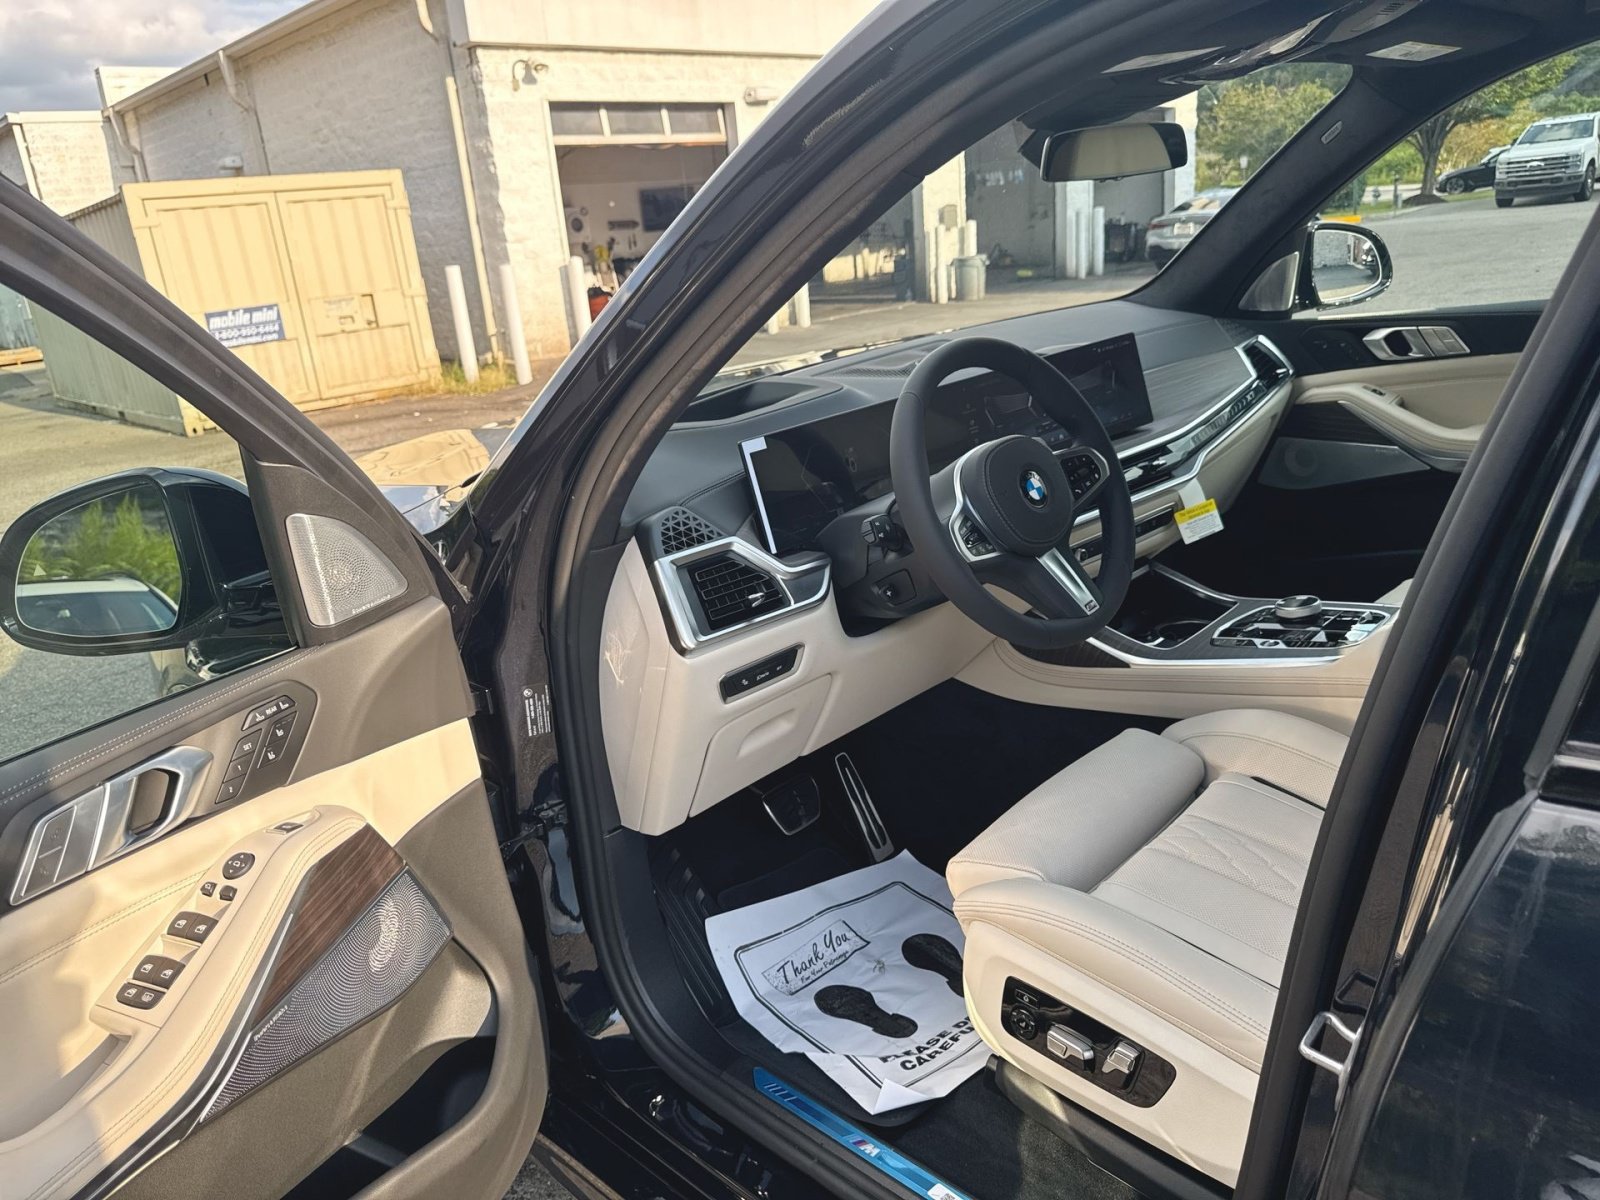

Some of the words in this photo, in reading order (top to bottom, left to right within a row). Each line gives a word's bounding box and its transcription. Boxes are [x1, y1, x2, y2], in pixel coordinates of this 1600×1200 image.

[209, 309, 251, 330] mobile
[251, 306, 278, 324] mini
[243, 742, 252, 751] SET
[777, 942, 824, 984] Thank
[824, 930, 851, 952] You
[900, 1025, 975, 1071] CAREFU
